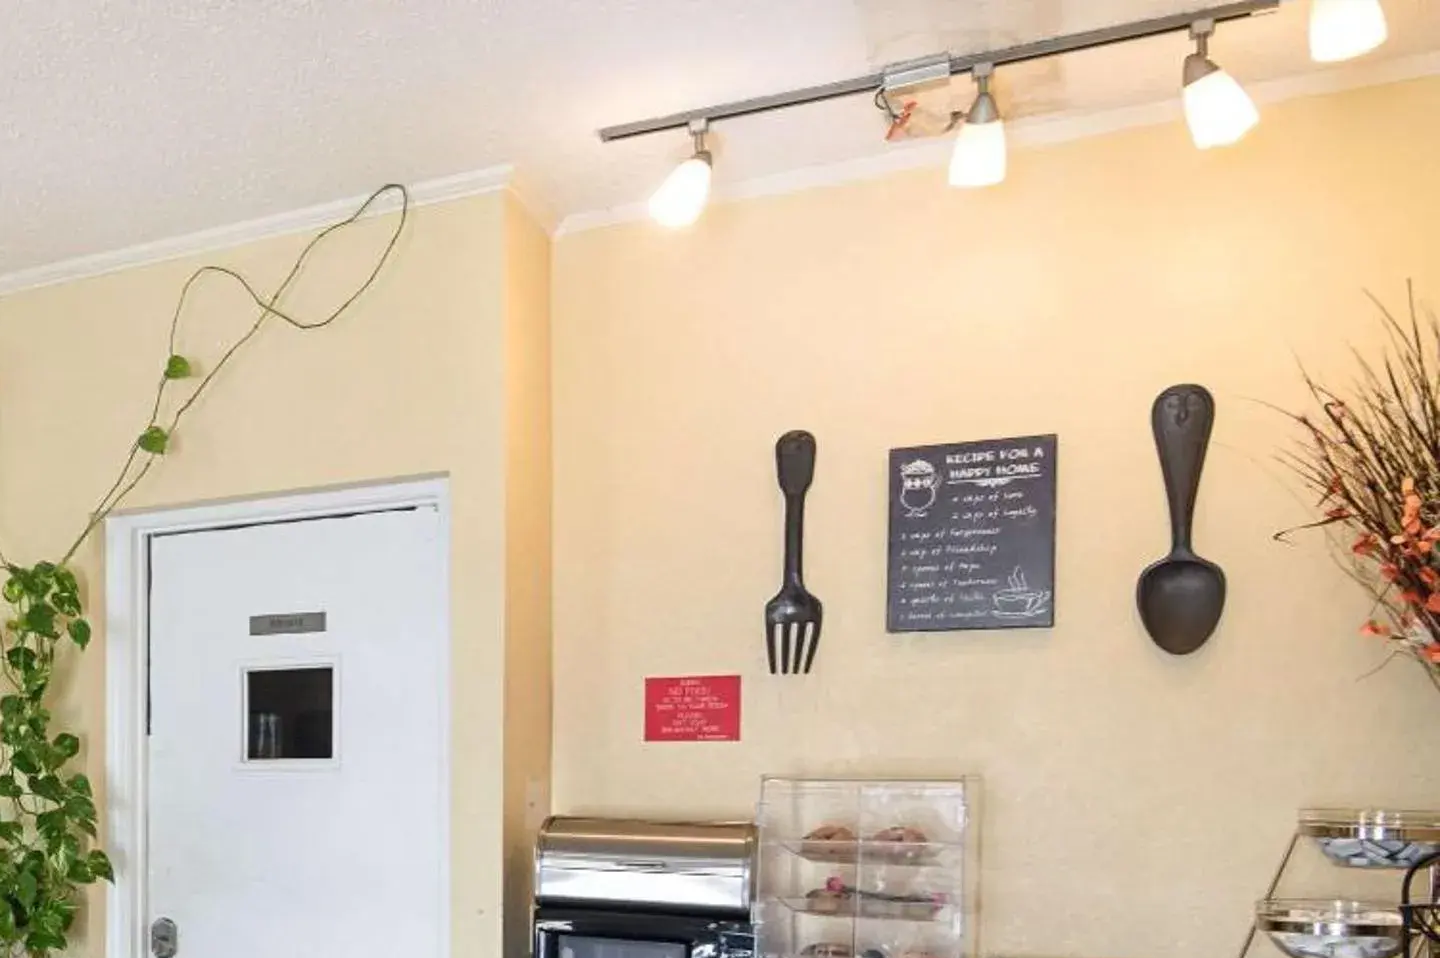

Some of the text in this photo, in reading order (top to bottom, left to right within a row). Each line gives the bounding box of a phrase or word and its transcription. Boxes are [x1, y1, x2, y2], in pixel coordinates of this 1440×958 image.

[946, 446, 1044, 464] RECIPE FOR A
[950, 462, 1040, 479] HAPPY HOME
